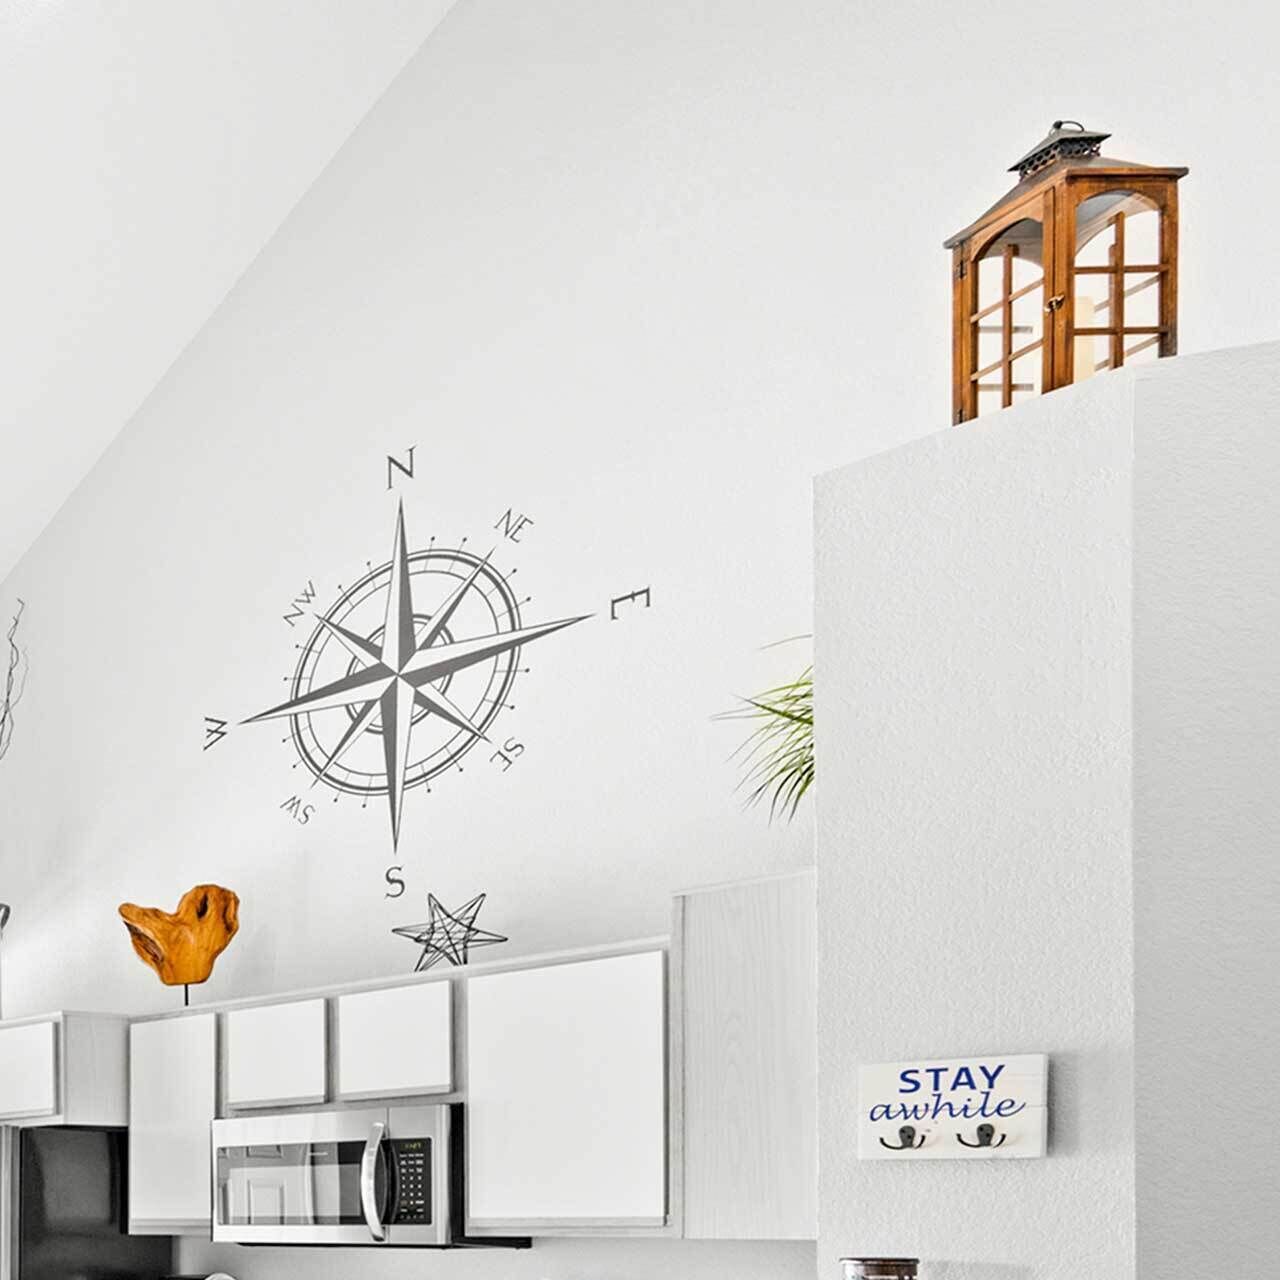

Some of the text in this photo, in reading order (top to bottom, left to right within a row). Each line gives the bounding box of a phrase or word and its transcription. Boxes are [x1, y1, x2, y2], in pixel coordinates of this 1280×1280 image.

[387, 445, 417, 491] N
[493, 507, 534, 544] NE
[282, 580, 318, 627] NW
[611, 587, 651, 620] E
[203, 715, 229, 751] W
[489, 736, 525, 772] SE
[280, 795, 316, 825] SW
[384, 865, 407, 899] S
[898, 1064, 1005, 1093] STAY
[869, 1091, 1026, 1122] awhile
